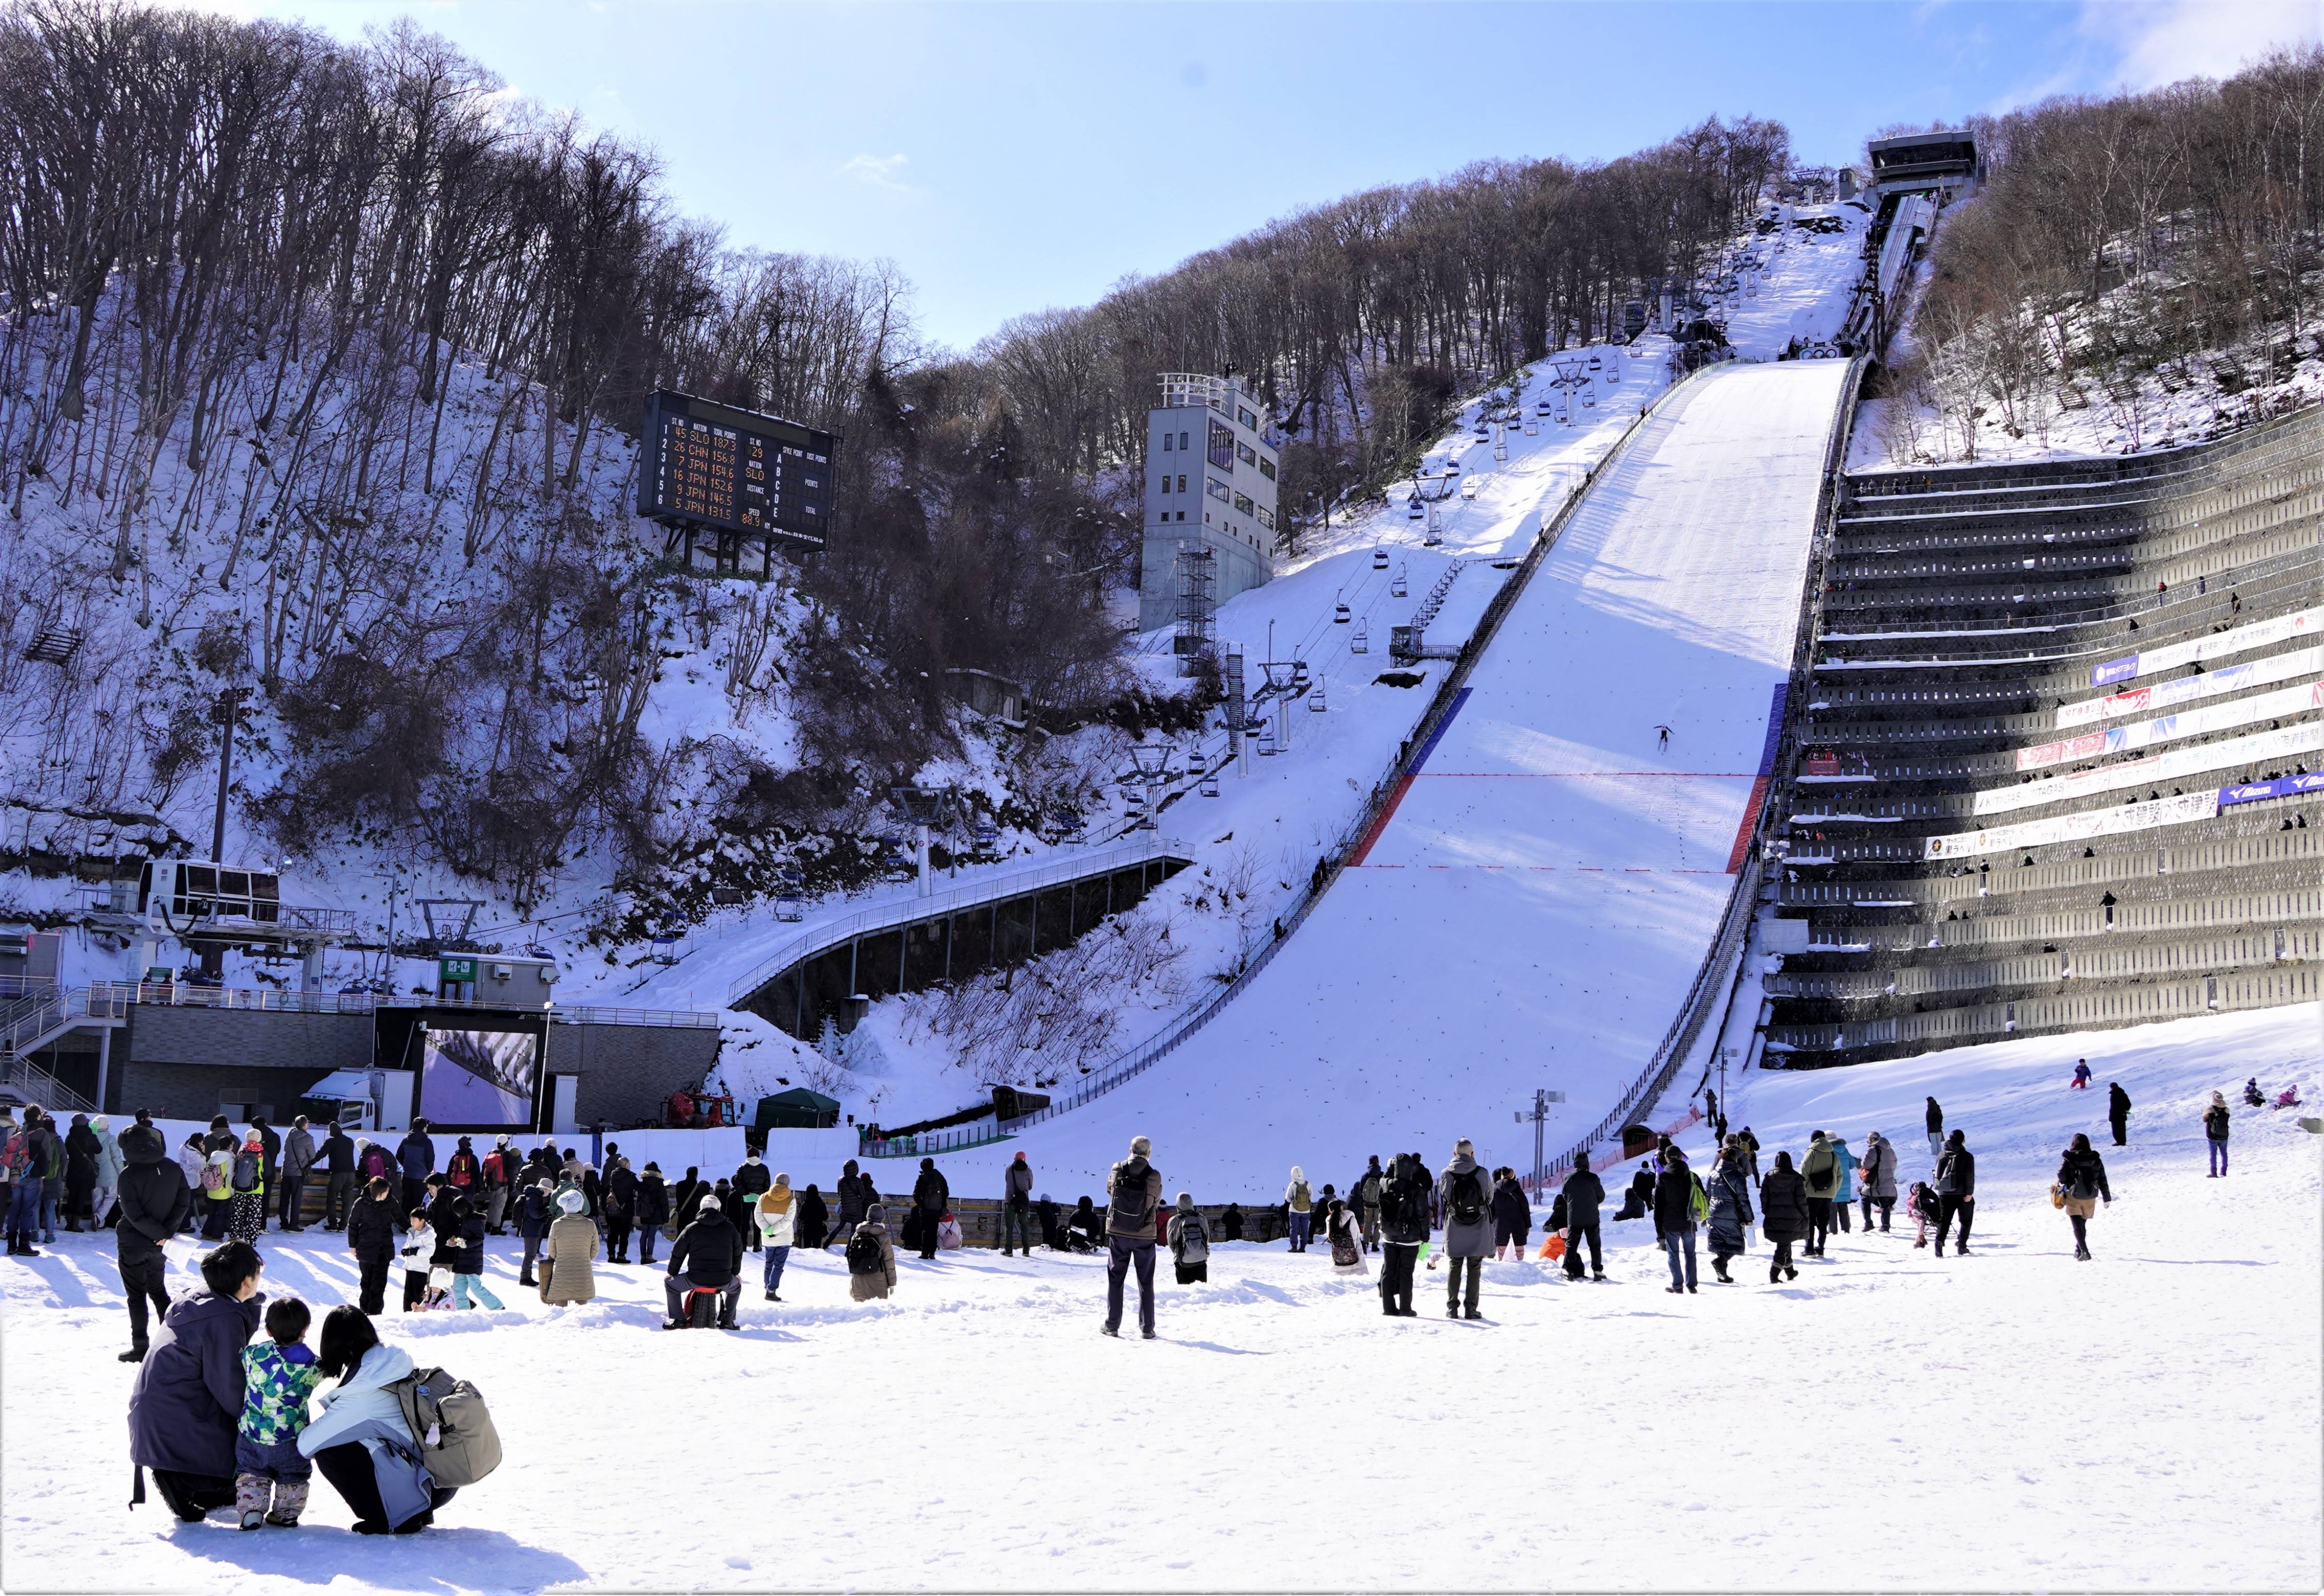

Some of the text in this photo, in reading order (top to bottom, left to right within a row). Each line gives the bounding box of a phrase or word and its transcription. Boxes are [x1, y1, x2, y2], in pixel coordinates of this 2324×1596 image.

[679, 419, 684, 427] NO
[693, 423, 707, 432] NATION
[664, 425, 668, 434] 1
[676, 427, 687, 439] 45
[724, 430, 736, 440] POINTS
[690, 430, 710, 444] SLO
[662, 439, 667, 448] 2
[674, 441, 685, 452] 26
[714, 436, 736, 451] 187.3
[756, 439, 761, 447] NO
[661, 452, 666, 462] 3
[688, 444, 709, 459] CHN
[752, 446, 763, 458] 29
[782, 446, 803, 458] STYLE POINT
[679, 456, 685, 466] 7
[713, 450, 735, 465] 156.8
[777, 453, 781, 464] A
[815, 455, 827, 464] POINTS
[687, 458, 708, 472] JPN
[749, 460, 762, 469] NATION
[660, 466, 665, 476] 4
[673, 468, 683, 480] 16
[712, 464, 734, 478] 154.6
[745, 467, 764, 481] SLO
[776, 467, 780, 477] B
[686, 472, 706, 486] JPN
[805, 478, 818, 488] POINTS
[659, 480, 664, 490] 5
[677, 484, 683, 494] 9
[711, 478, 733, 492] 152.6
[747, 484, 764, 494] DISTANCE
[775, 480, 780, 490] C
[685, 486, 705, 500] JPN
[658, 494, 663, 504] 6
[676, 497, 682, 509] 5
[710, 492, 732, 506] 146.5
[774, 494, 779, 504] D
[684, 500, 704, 514] JPN
[709, 505, 732, 520] 131.5
[748, 507, 760, 517] SPEED
[774, 507, 778, 518] E
[806, 506, 816, 515] TOTAL
[742, 513, 760, 527] 88.9
